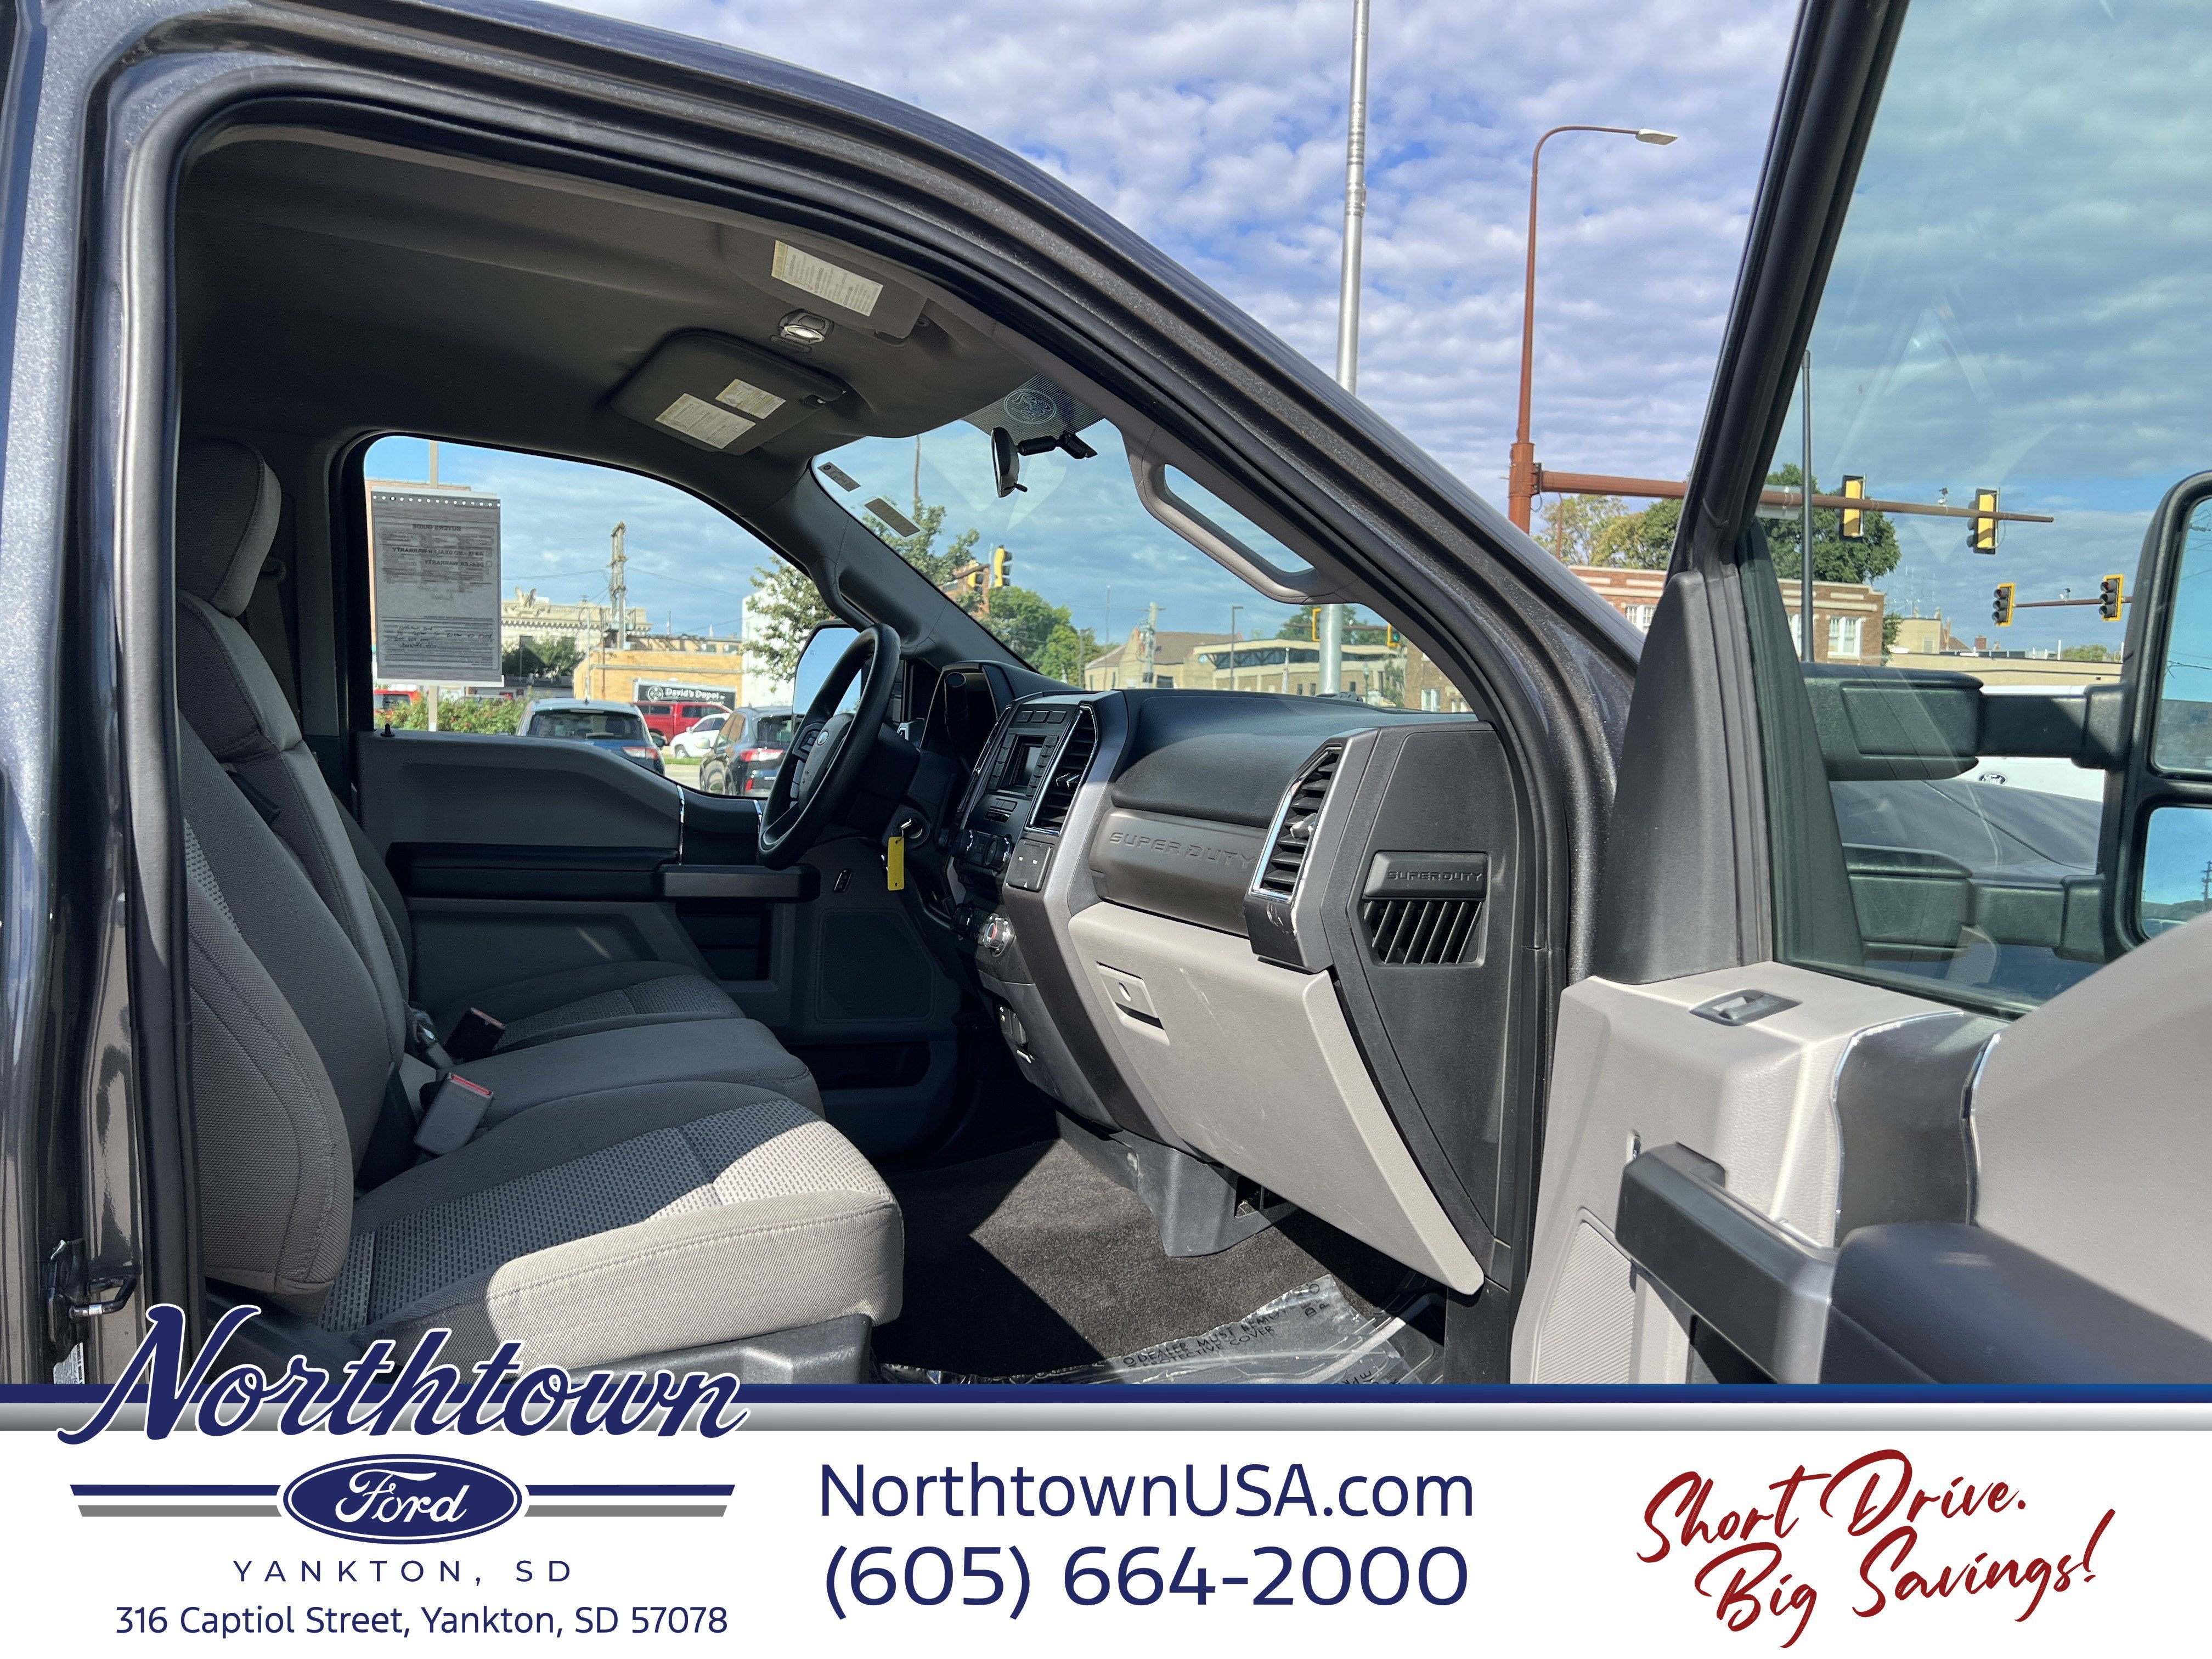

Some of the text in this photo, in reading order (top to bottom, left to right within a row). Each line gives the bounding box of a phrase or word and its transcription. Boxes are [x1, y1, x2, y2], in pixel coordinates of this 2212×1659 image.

[664, 687, 695, 697] David's
[695, 690, 720, 700] Depot
[1109, 832, 1256, 869] SUPER DUTY
[1197, 1325, 1234, 1348] MUST
[1229, 1325, 1276, 1345] COVER
